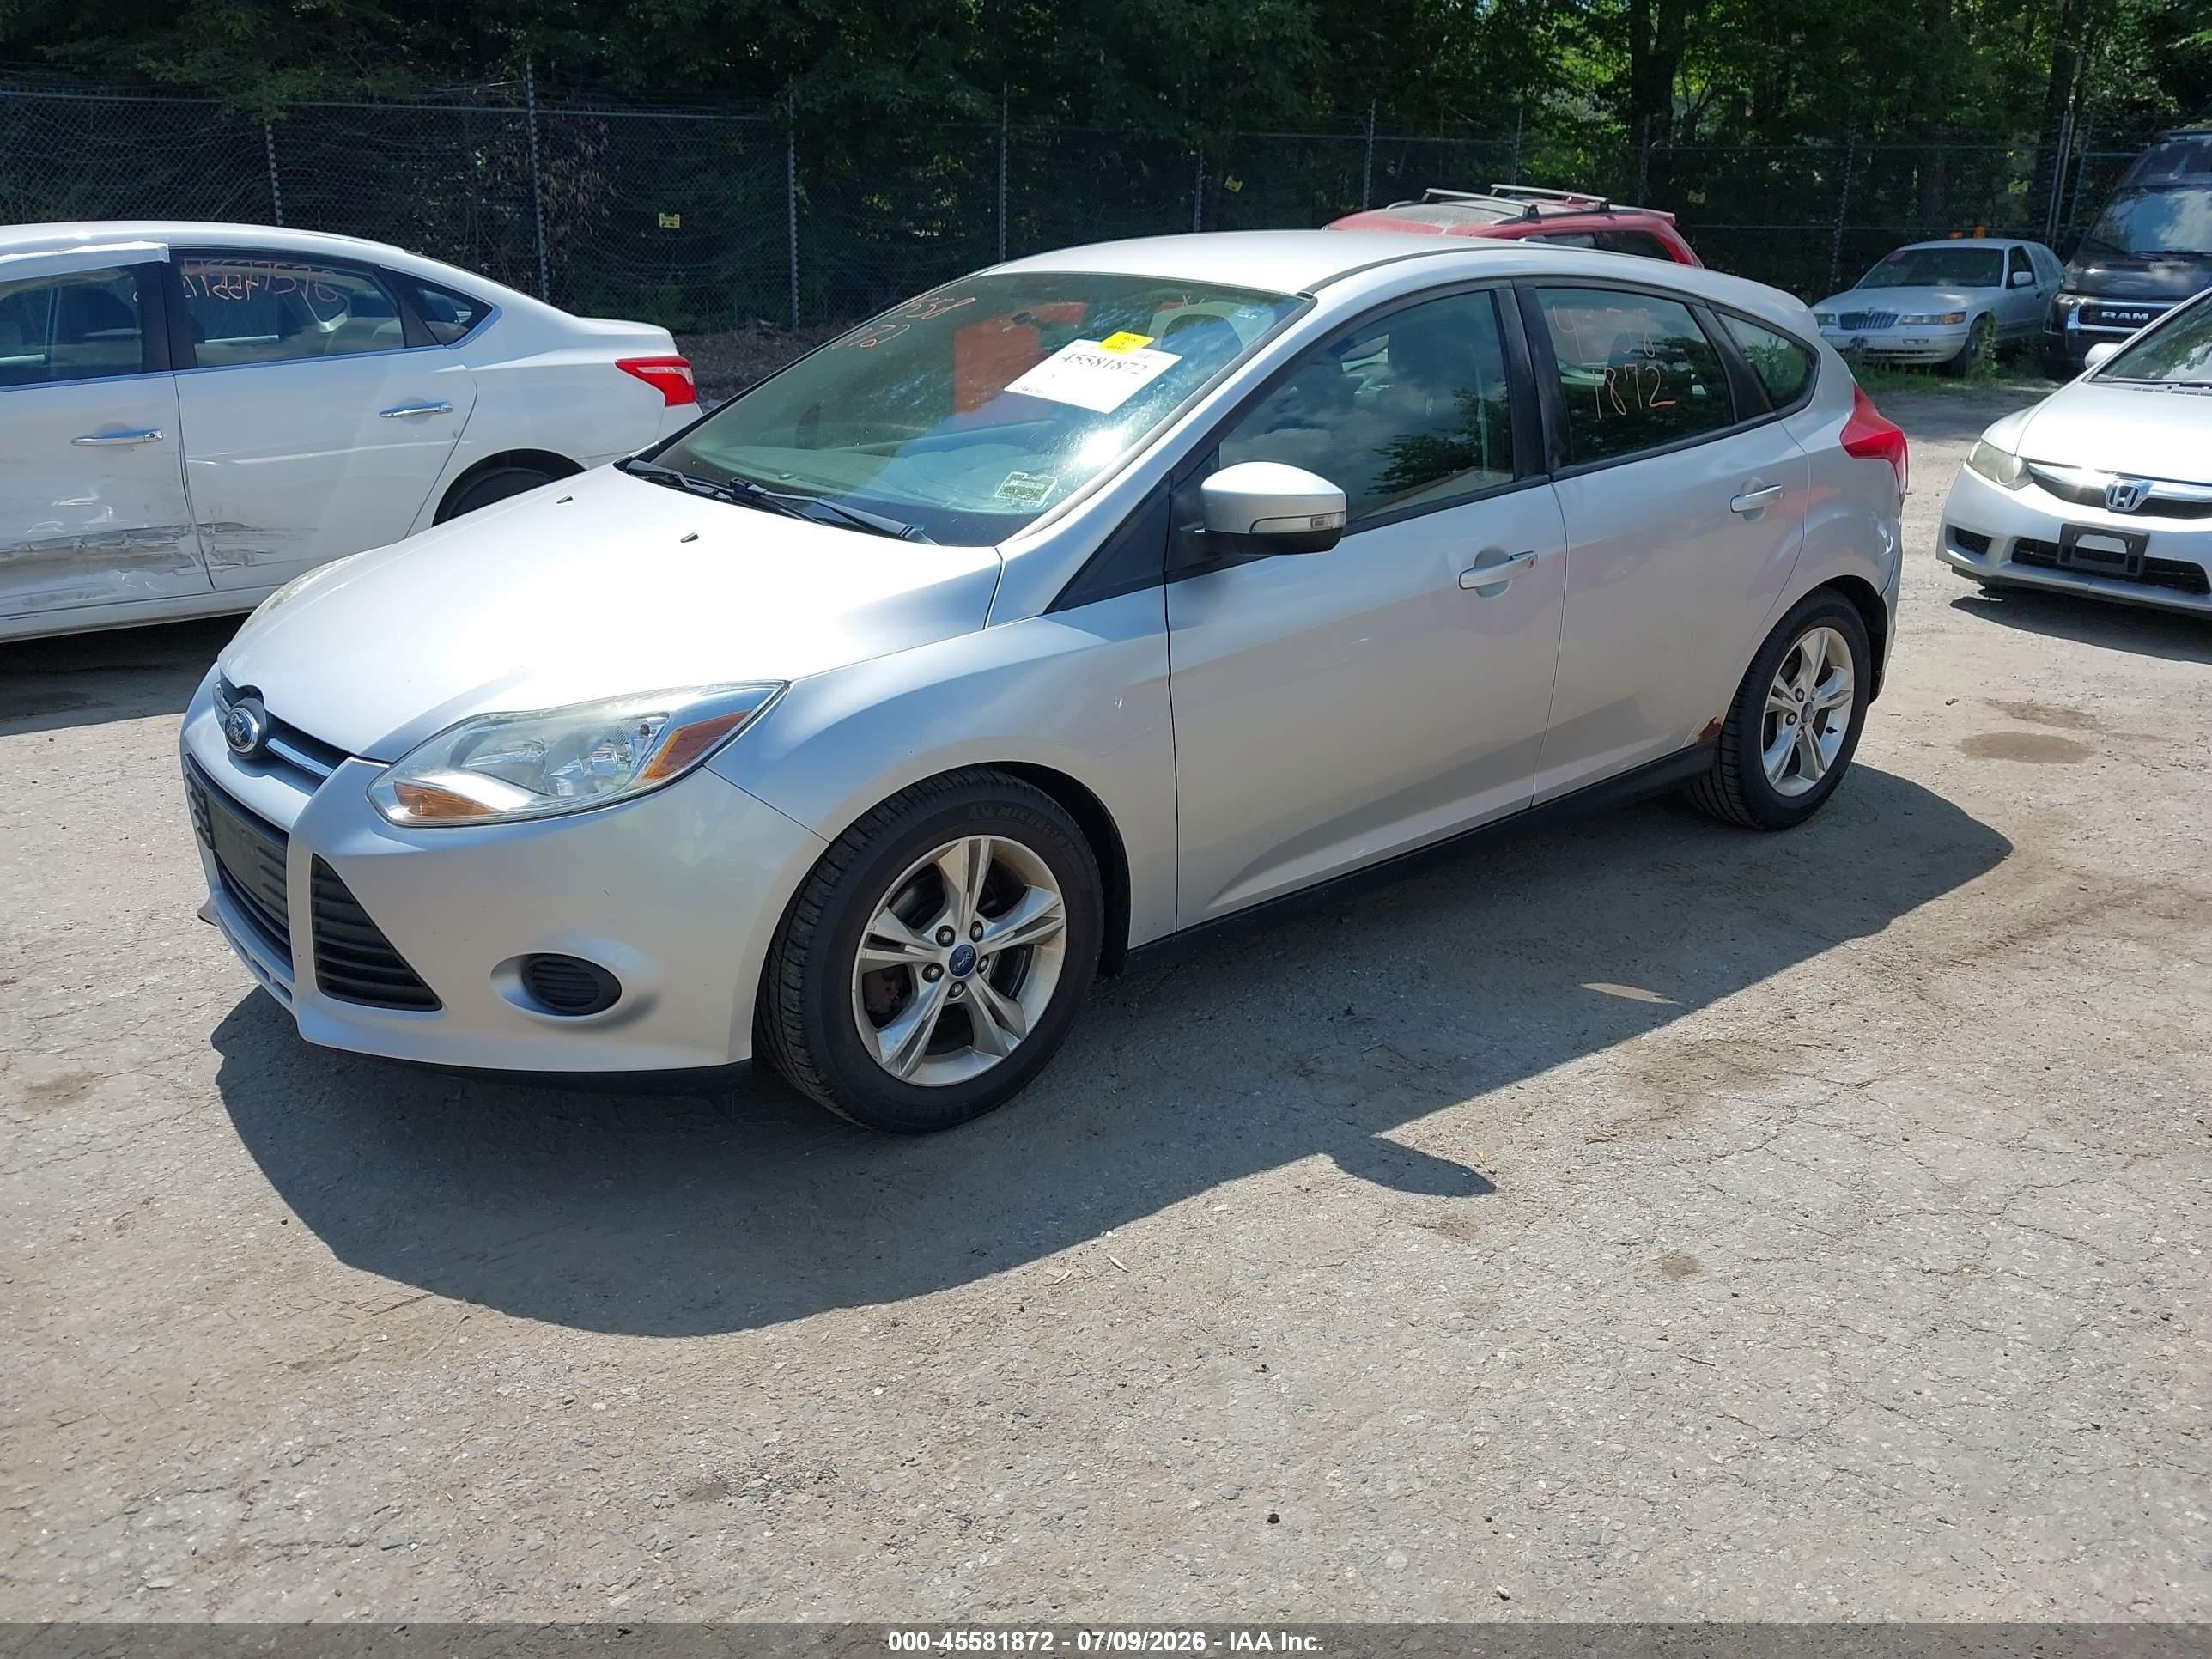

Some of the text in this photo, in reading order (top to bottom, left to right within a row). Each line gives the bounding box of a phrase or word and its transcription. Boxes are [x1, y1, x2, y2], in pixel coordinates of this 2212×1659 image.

[2101, 311, 2149, 321] RAM
[1061, 353, 1148, 375] 45581872
[1591, 363, 1677, 420] 1872
[227, 714, 246, 743] Ford
